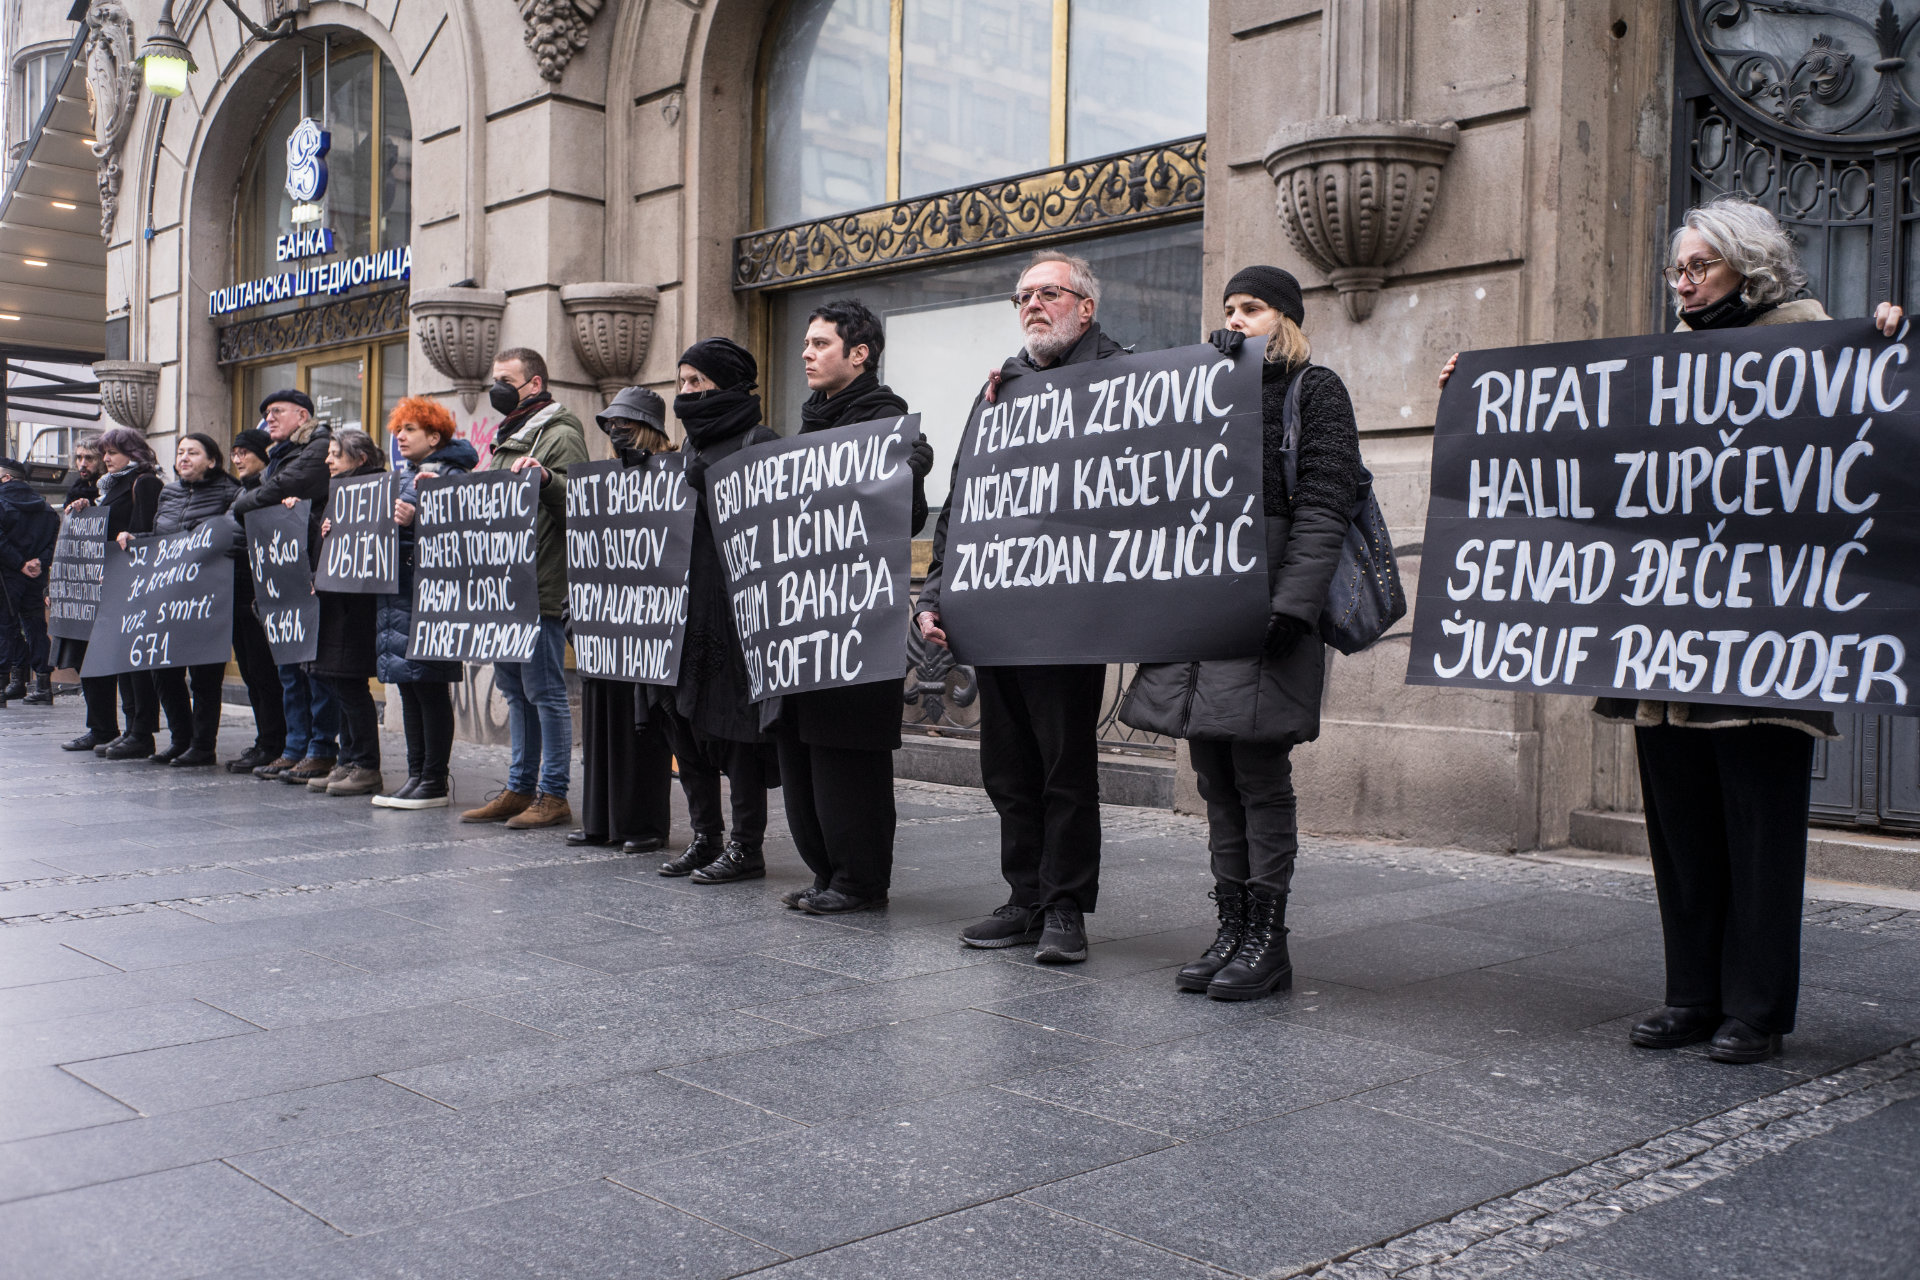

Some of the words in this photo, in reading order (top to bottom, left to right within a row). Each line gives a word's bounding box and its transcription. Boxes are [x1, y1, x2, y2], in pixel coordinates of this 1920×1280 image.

[276, 228, 327, 262] БАНКА
[209, 272, 291, 315] ПОШТАНСКА
[295, 245, 412, 297] ШТЕДИОНИЦА
[1472, 359, 1627, 435] RIFAT
[1649, 319, 1911, 428] HUSOVIĆ
[973, 381, 1076, 456] FEVZIJA
[605, 456, 688, 516] BABAČIĆ
[714, 471, 741, 524] ESAD
[744, 416, 905, 509] KAPETANOVIĆ
[960, 463, 1060, 524] NIJAZIM
[1073, 421, 1235, 510] KAJEVIĆ
[1467, 457, 1595, 519] HALIL
[1614, 417, 1881, 519] ZUPČEVIĆ
[420, 486, 454, 526] SAFET
[773, 495, 869, 564] LIČINA
[153, 523, 214, 568] Beograda
[463, 517, 536, 566] TOPUZOVIĆ
[566, 529, 600, 569] TOMO
[602, 526, 668, 570] BUZOV
[950, 531, 1097, 593] ZVJEZDAN
[1102, 494, 1258, 584] ZULIČIĆ
[1447, 538, 1616, 605] SENAD
[1620, 518, 1874, 612] ĐEČEVIĆ
[156, 593, 216, 625] smrti
[418, 577, 461, 612] RASIM
[467, 565, 516, 612] ĆORIĆ
[568, 582, 602, 622] ADEM
[602, 569, 689, 626] ALOMEROVIĆ
[733, 580, 770, 641] FEHIM
[777, 553, 894, 627] BAKIJA
[129, 632, 172, 667] 671
[412, 620, 471, 658] FIKRET
[468, 614, 542, 659] MEMOVIĆ
[622, 626, 674, 680] HANIĆ
[766, 613, 863, 692] SOFTIĆ
[1433, 610, 1598, 687] JUSUF
[1611, 624, 1909, 706] RASTODER
